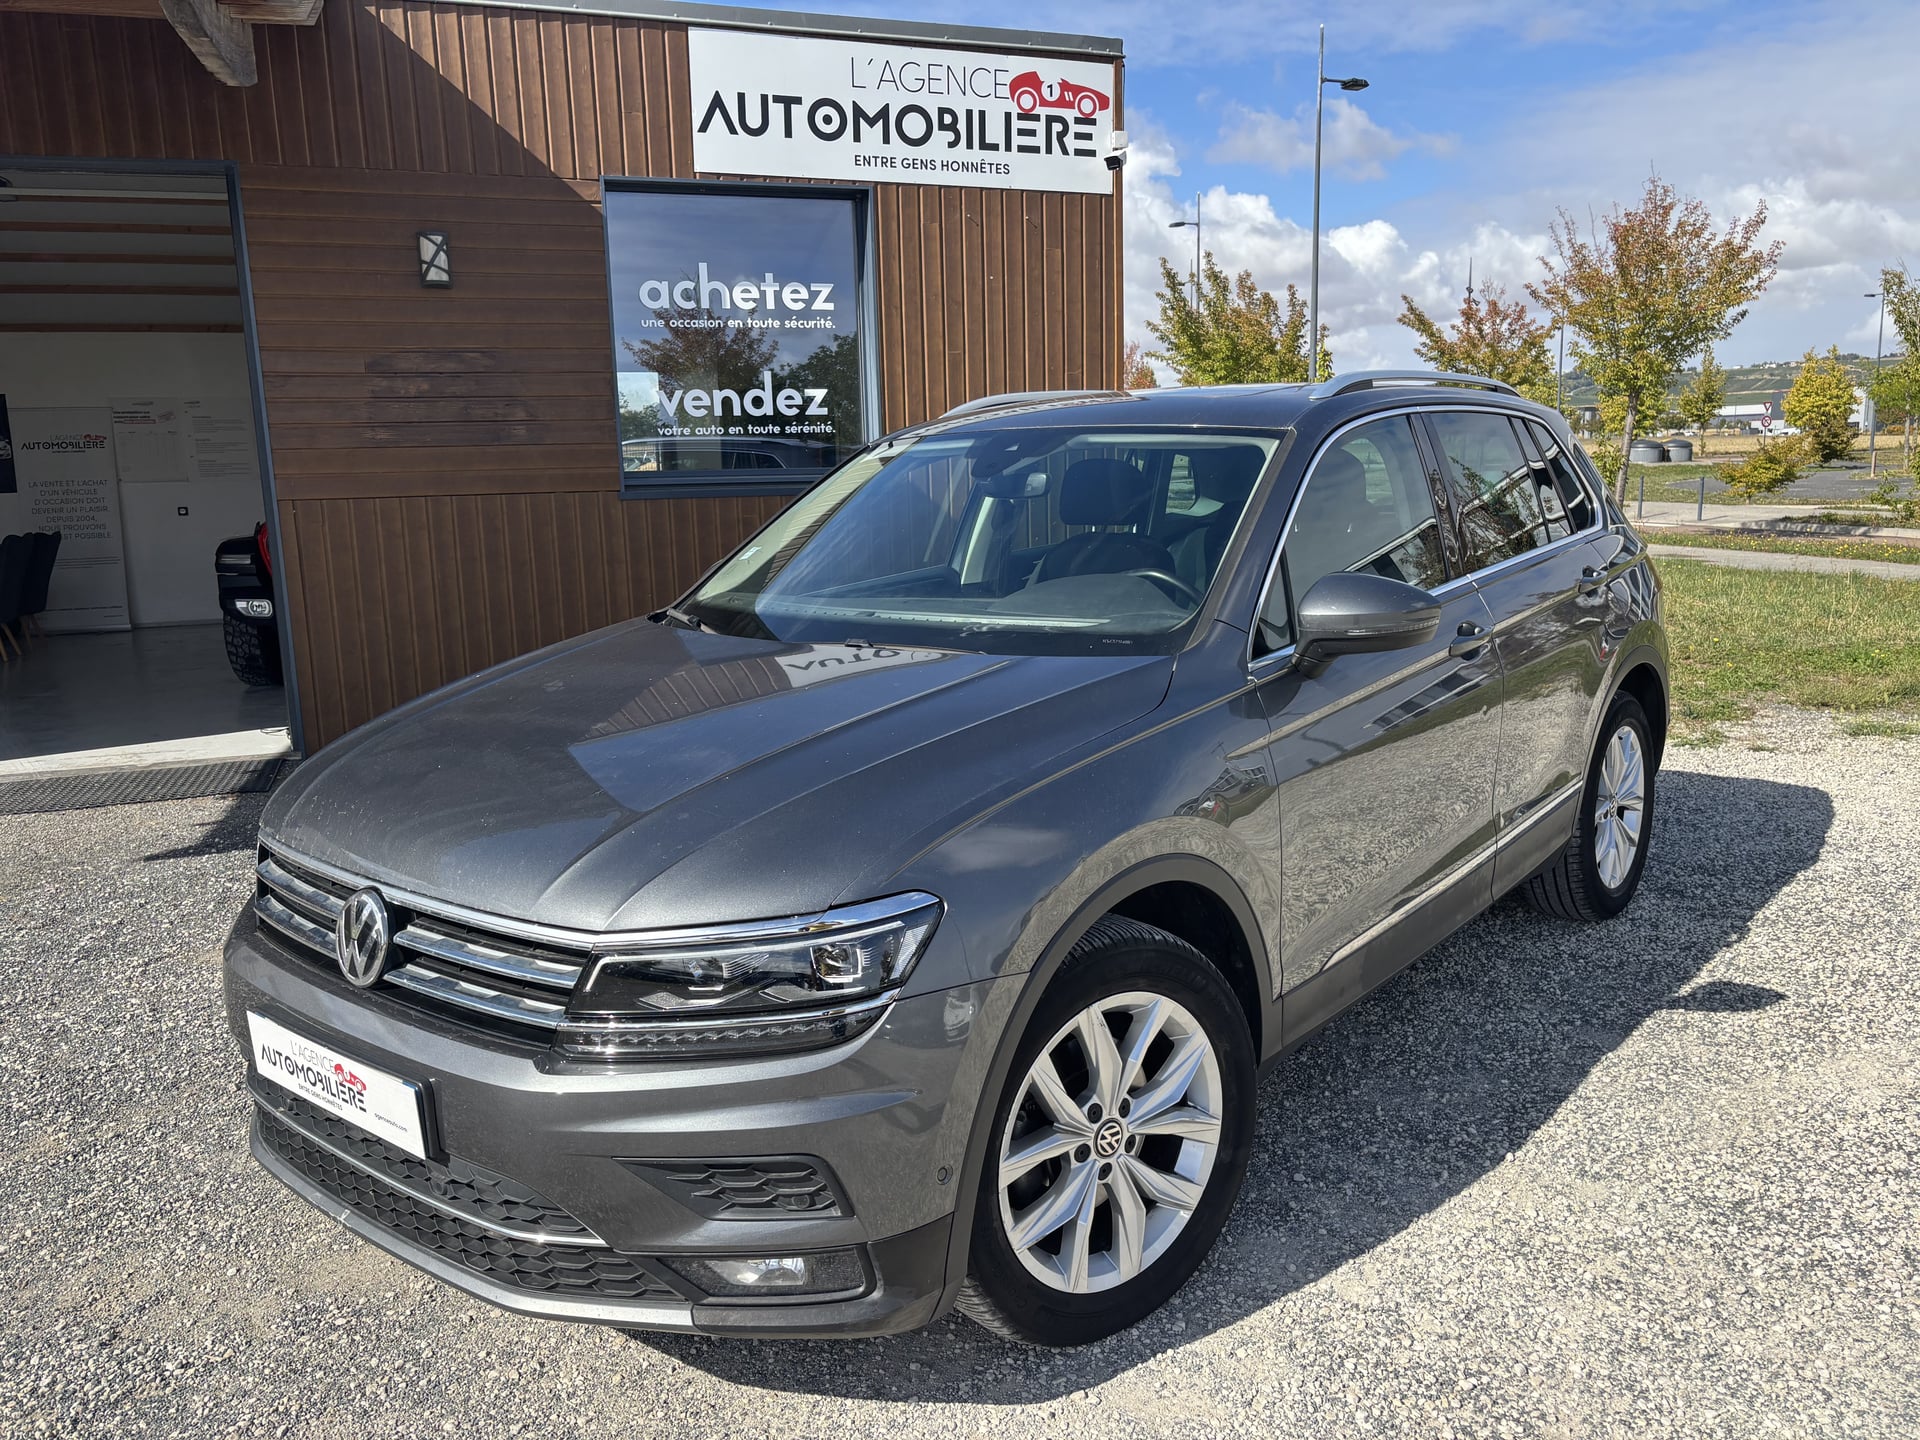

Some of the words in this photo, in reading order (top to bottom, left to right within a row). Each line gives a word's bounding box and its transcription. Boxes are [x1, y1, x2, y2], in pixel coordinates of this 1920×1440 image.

[850, 57, 1010, 100] L'AGENCE
[854, 154, 897, 169] ENTRE
[901, 157, 937, 171] GENS
[941, 158, 1010, 175] HONNÊTES
[638, 262, 835, 311] achetez
[641, 319, 665, 328] une
[670, 317, 724, 328] occasion
[727, 318, 743, 328] en
[747, 317, 781, 329] toute
[784, 316, 836, 329] sécurité.
[657, 371, 828, 417] vendez
[657, 425, 691, 436] votre
[695, 424, 725, 435] auto
[728, 425, 744, 435] en
[748, 423, 781, 434] toute
[784, 421, 836, 434] sérénité.
[86, 496, 105, 504] DOIT
[290, 1040, 337, 1075] L'AGENCE
